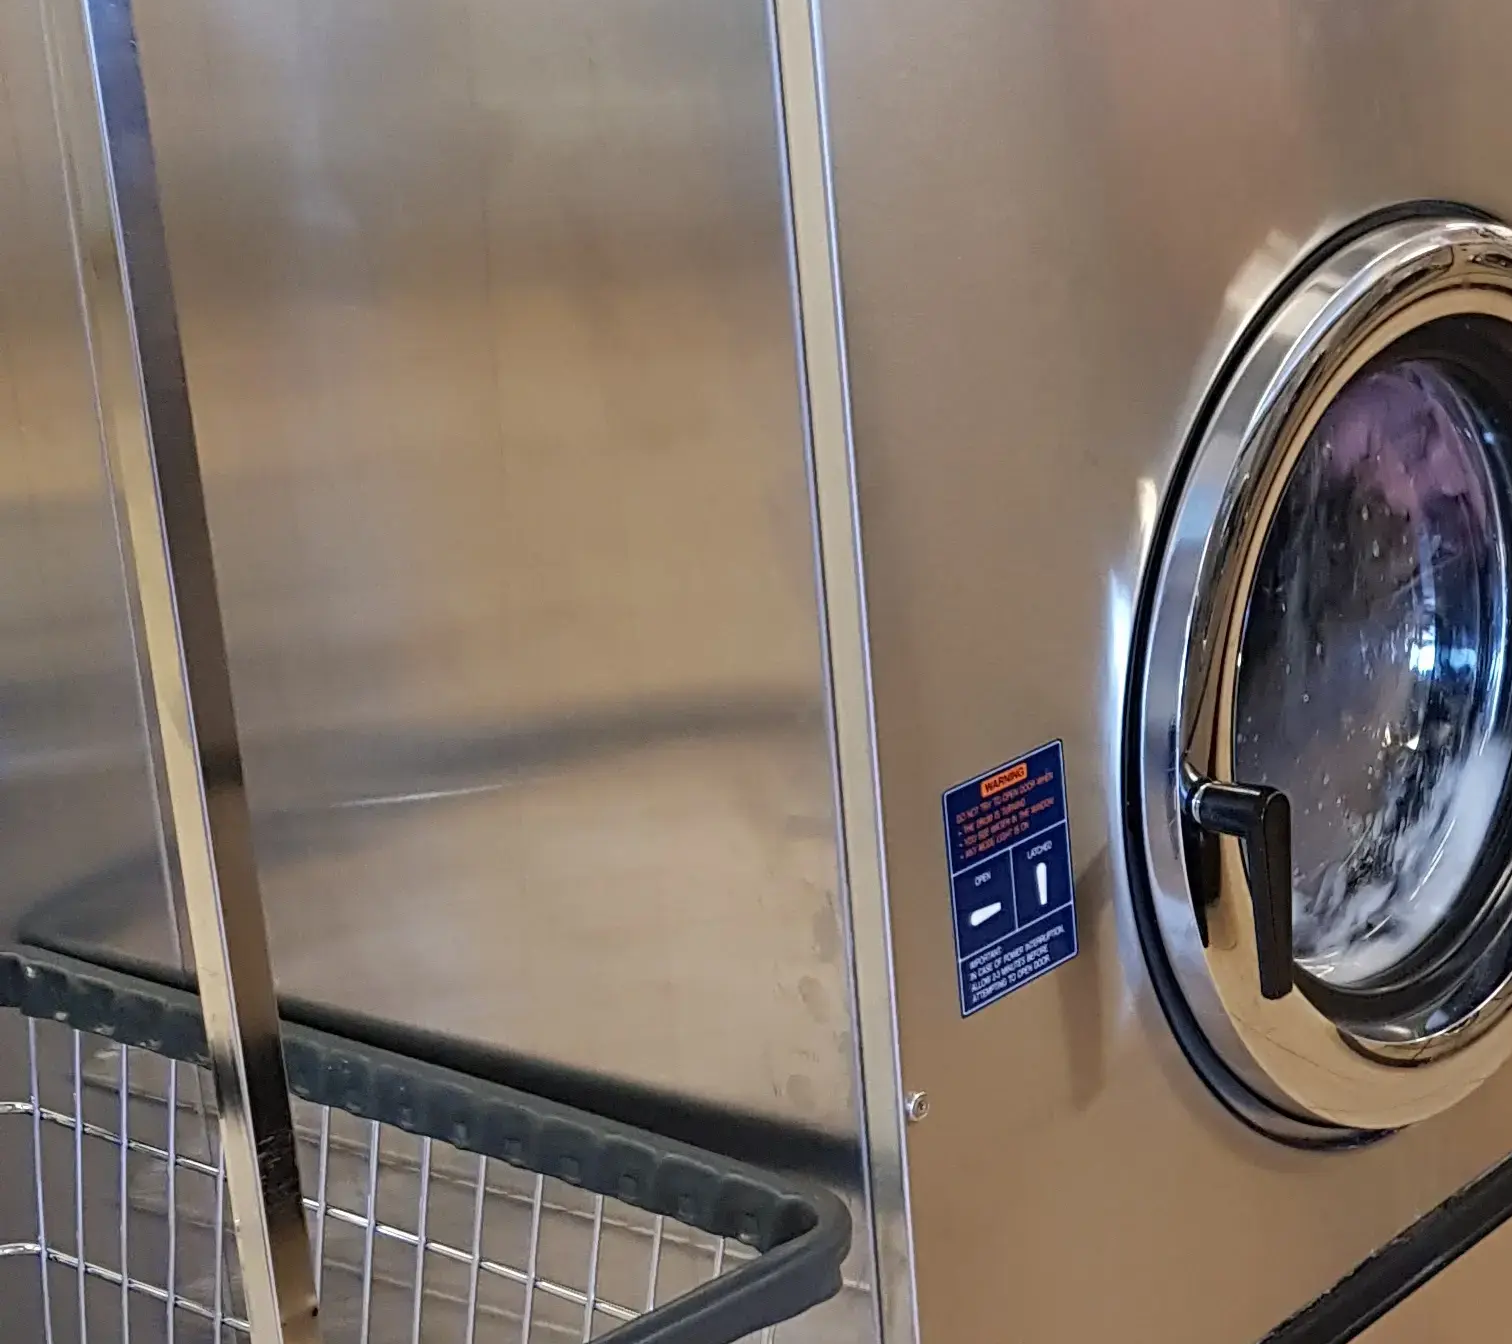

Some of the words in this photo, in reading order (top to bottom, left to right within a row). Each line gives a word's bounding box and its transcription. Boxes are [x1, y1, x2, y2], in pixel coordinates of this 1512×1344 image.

[984, 766, 1025, 793] WARNING
[1026, 840, 1053, 860] LATCHED
[974, 871, 992, 887] OPEN
[1016, 964, 1034, 979] OPEN
